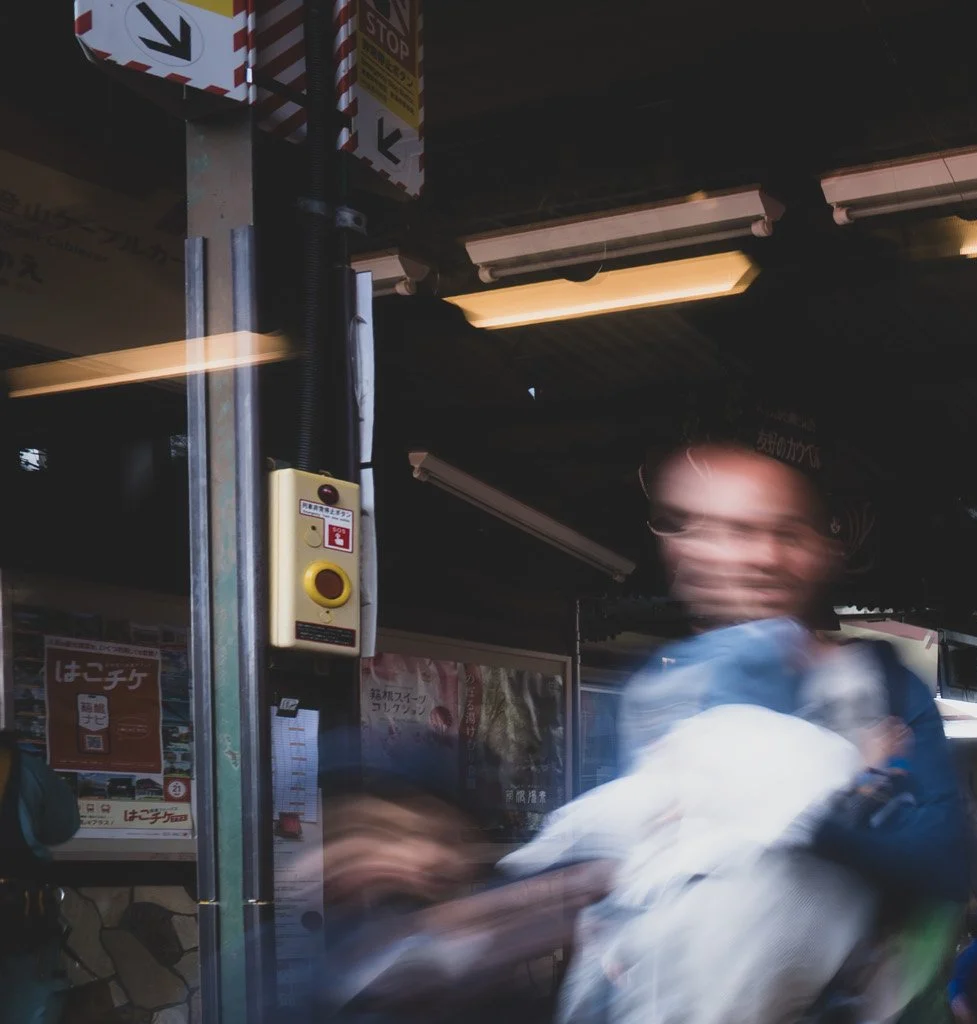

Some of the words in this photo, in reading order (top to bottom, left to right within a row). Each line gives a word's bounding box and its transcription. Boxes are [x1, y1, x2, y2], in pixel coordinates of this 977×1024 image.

[366, 11, 410, 61] STOP
[332, 526, 346, 535] SOS
[55, 660, 149, 691] はこチケ
[371, 688, 427, 705] 箱根スイーツ
[124, 809, 173, 825] はこチケ
